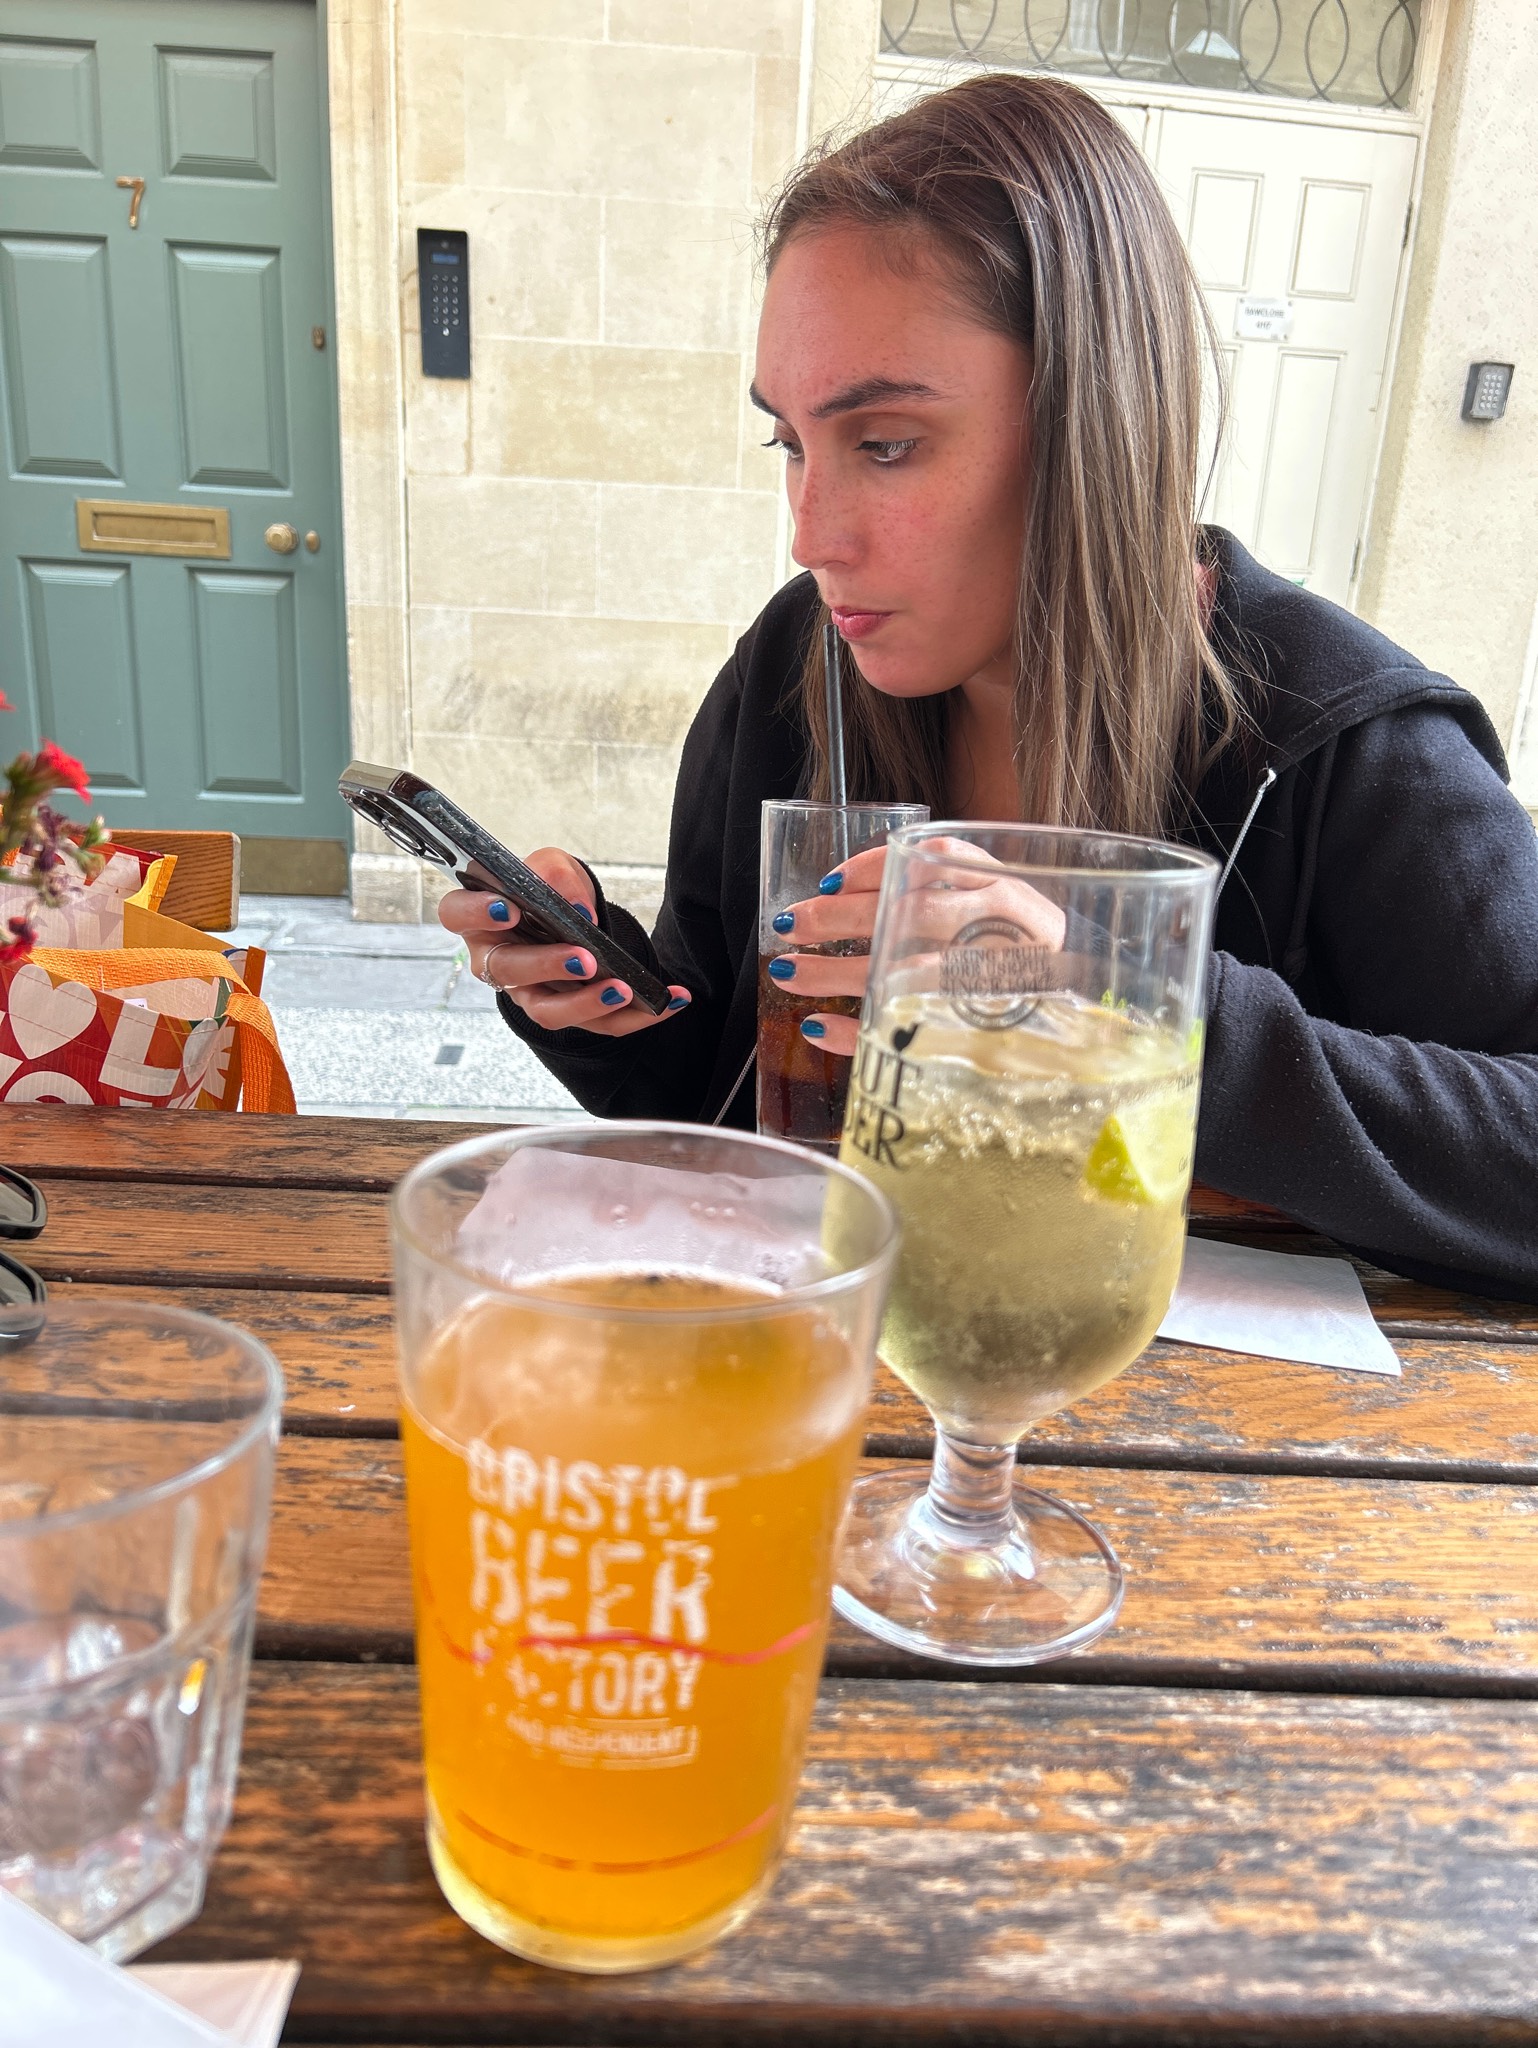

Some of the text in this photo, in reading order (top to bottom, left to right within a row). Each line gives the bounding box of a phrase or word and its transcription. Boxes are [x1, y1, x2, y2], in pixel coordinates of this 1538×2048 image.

[115, 176, 145, 228] 7
[467, 1436, 720, 1535] BRISTOL
[470, 1508, 714, 1645] BEER
